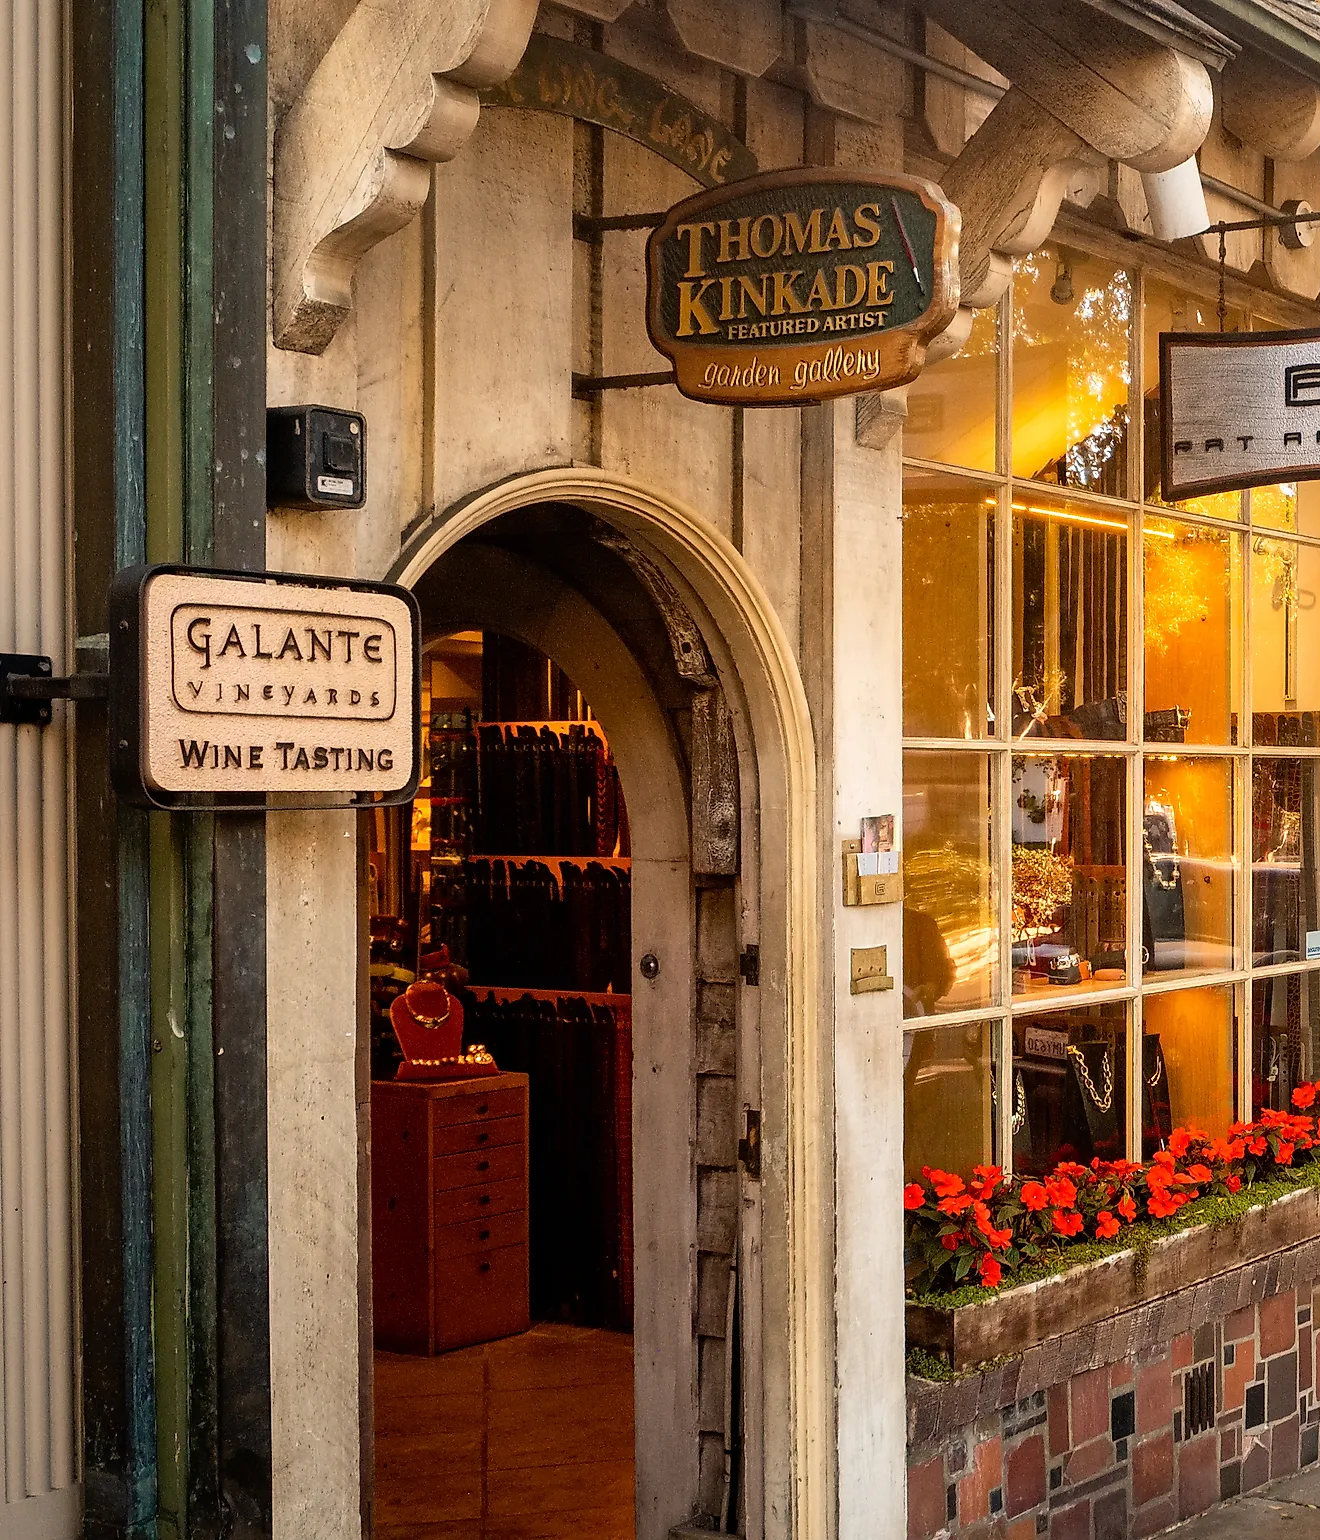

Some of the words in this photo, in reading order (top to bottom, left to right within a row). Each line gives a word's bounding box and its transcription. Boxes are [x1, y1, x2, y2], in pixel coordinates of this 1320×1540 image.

[676, 203, 882, 278] THOMAS
[675, 260, 896, 337] KINKADE
[727, 317, 820, 340] FEATURED
[822, 311, 889, 332] ARTIST
[698, 356, 781, 389] garden
[789, 346, 881, 390] gallery
[1174, 435, 1254, 455] PAT
[186, 617, 383, 669] GALANTE
[188, 681, 380, 708] VINEYARDS
[178, 739, 264, 769] WINE
[275, 741, 394, 771] TASTING
